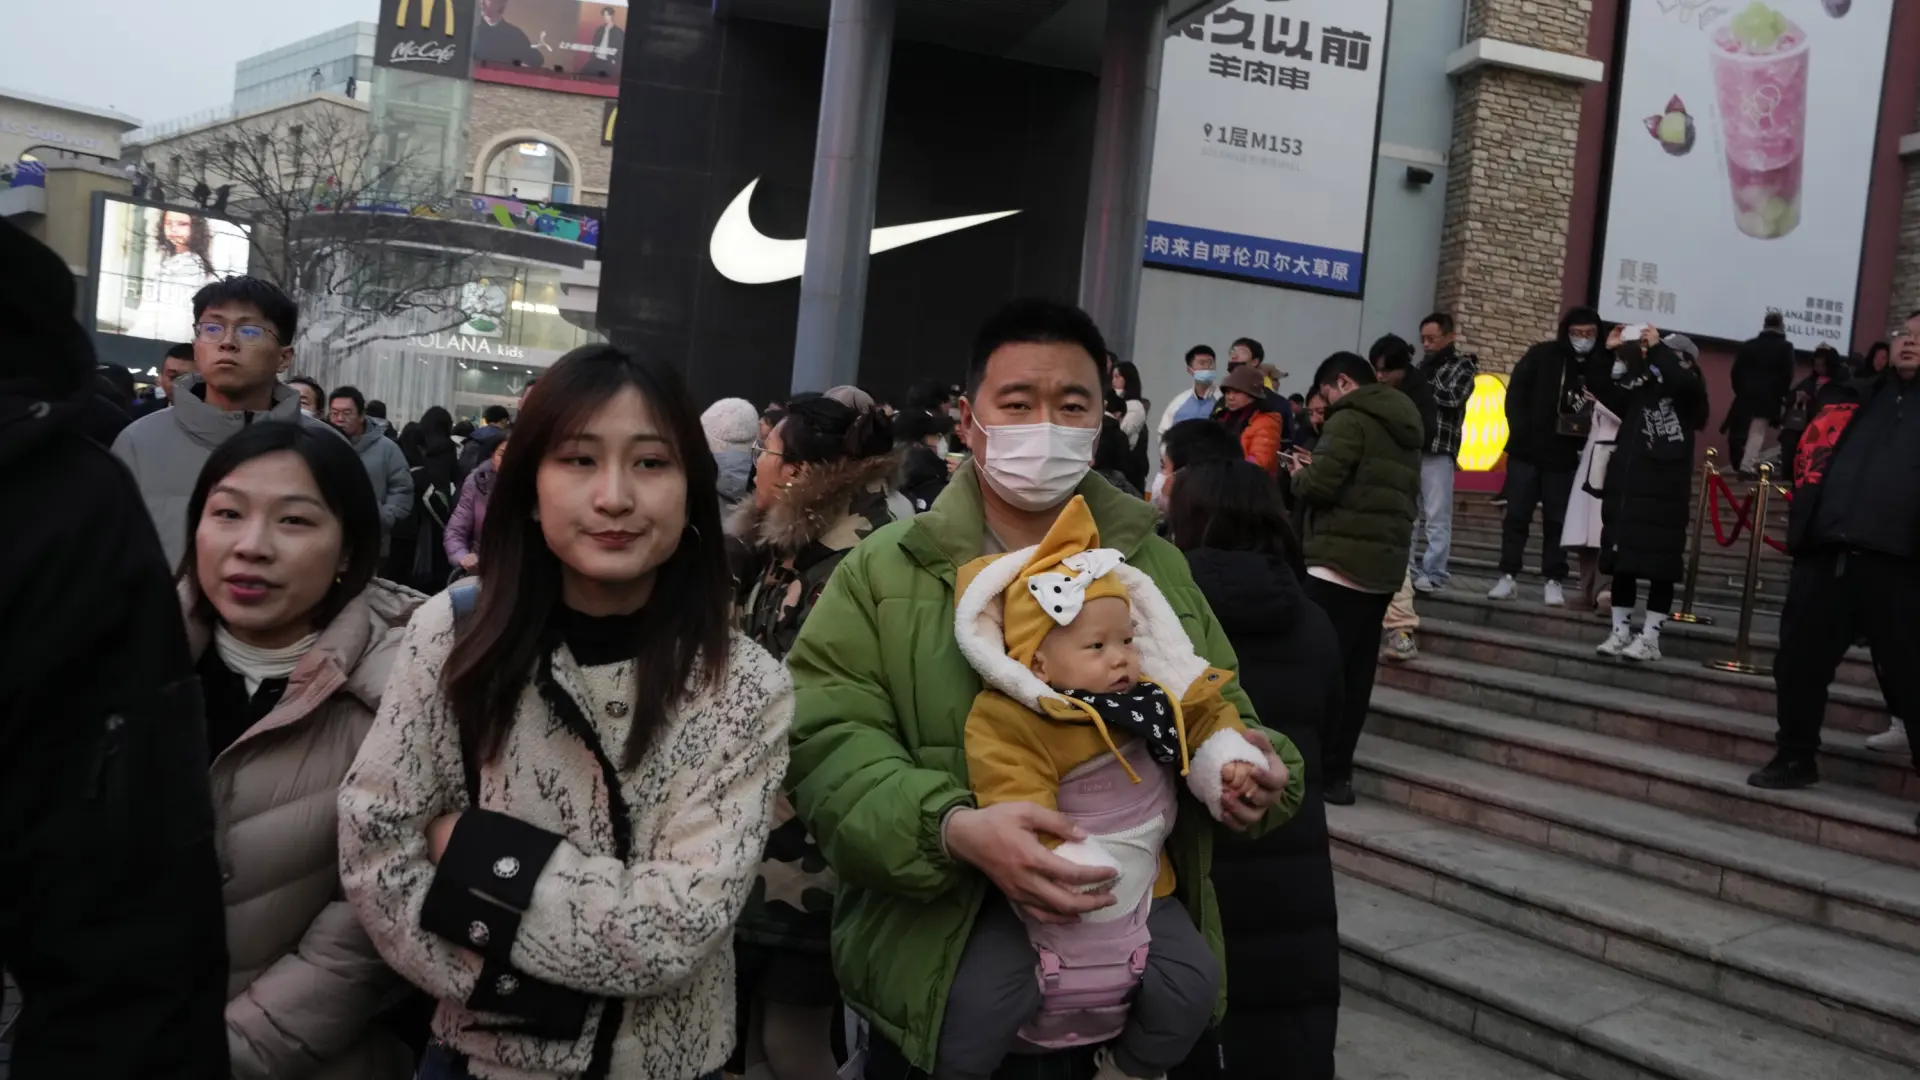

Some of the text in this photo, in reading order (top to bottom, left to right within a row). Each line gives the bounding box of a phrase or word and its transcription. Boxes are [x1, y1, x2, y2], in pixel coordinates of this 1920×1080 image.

[1208, 53, 1310, 91] 羊肉串
[1217, 126, 1303, 156] 1层M153
[1143, 234, 1350, 281] 肉来自呼伦贝尔大草原
[1615, 286, 1677, 315] 无香精
[406, 331, 524, 358] SOLANA kids
